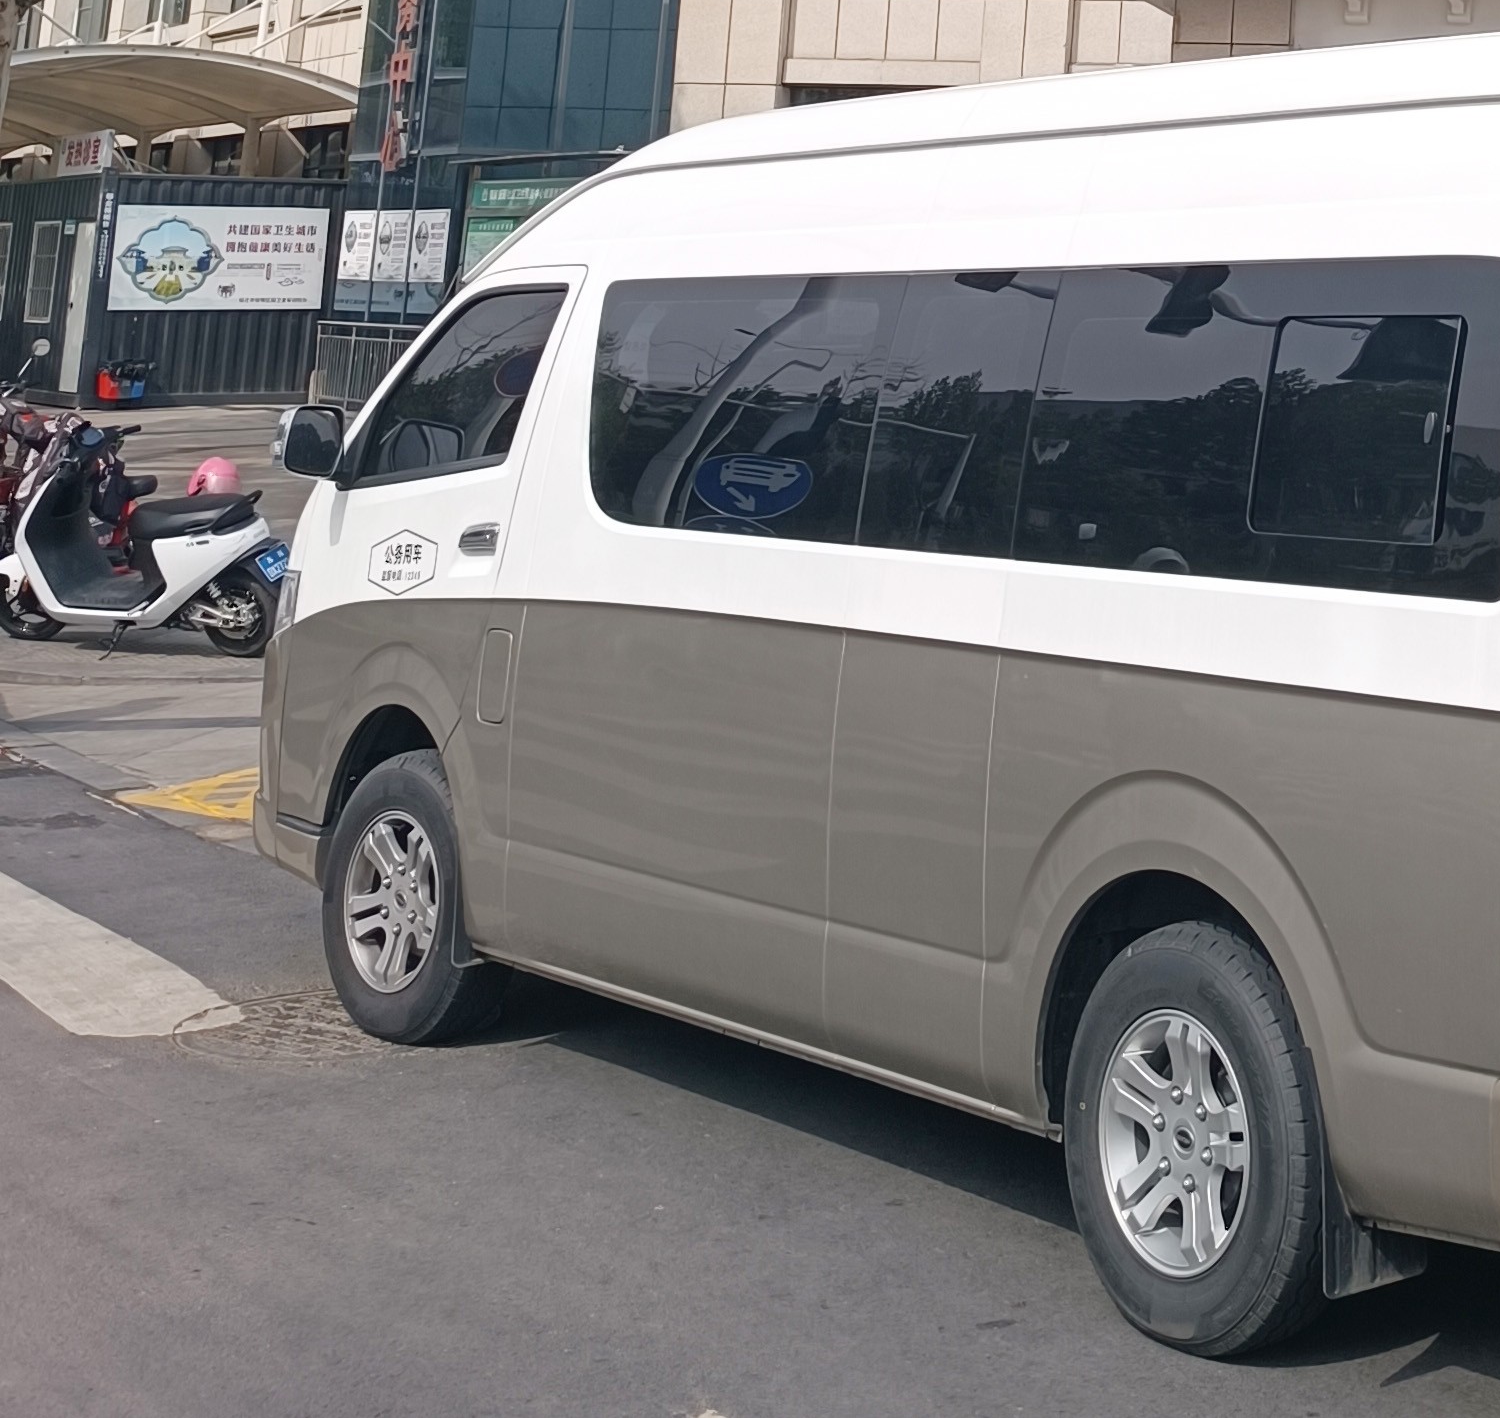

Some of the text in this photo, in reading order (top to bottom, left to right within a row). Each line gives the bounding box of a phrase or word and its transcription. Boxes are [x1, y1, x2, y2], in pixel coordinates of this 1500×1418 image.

[226, 224, 318, 237] 共建国家卫生城市
[384, 543, 423, 565] 公务用车
